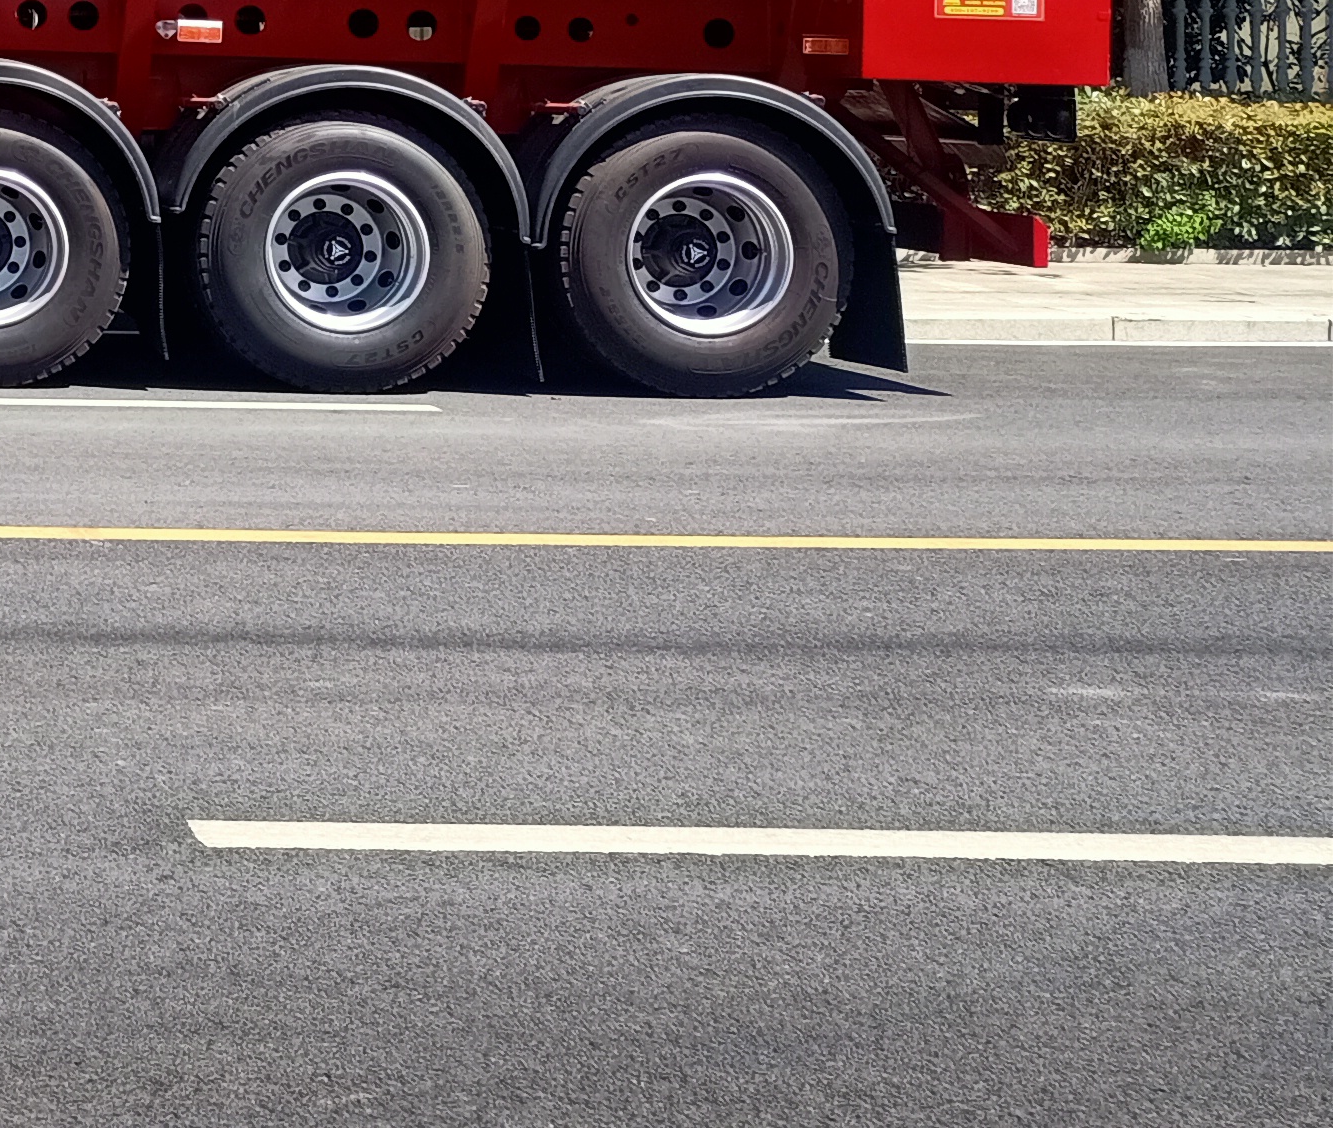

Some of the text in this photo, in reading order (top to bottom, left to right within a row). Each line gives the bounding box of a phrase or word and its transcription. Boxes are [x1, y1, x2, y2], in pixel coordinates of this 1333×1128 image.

[45, 159, 104, 325] CHENGSHAN
[345, 329, 426, 365] CST27
[703, 260, 829, 371] CHENGSHA
